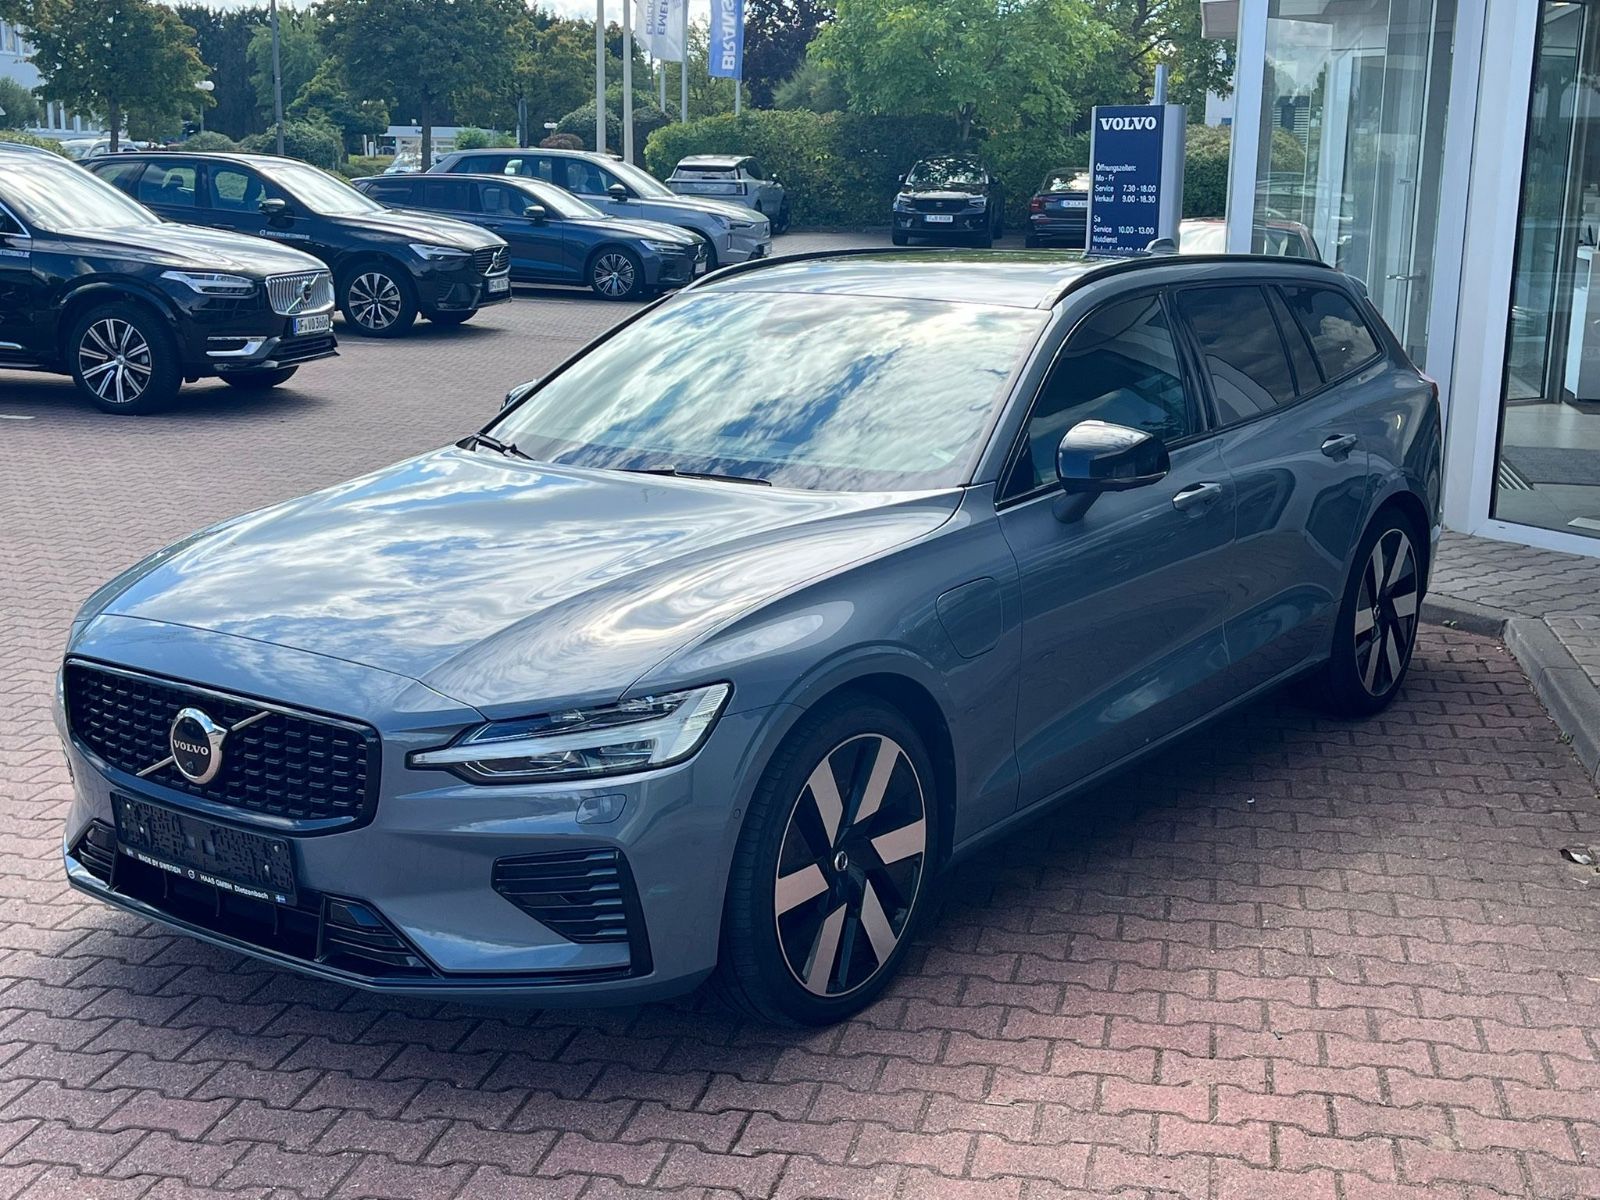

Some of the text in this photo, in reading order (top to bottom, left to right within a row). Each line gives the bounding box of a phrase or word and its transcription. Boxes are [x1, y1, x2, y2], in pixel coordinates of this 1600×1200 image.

[1099, 116, 1157, 131] VOLVO
[1122, 195, 1136, 203] 9.00
[1140, 195, 1156, 204] 18.30
[1118, 225, 1134, 234] 10.00
[1138, 226, 1155, 235] 13.00
[173, 739, 209, 756] VOLVO
[159, 861, 182, 874] SWEDEN
[199, 873, 215, 885] HAAS
[234, 885, 269, 899] Dietzenbach
